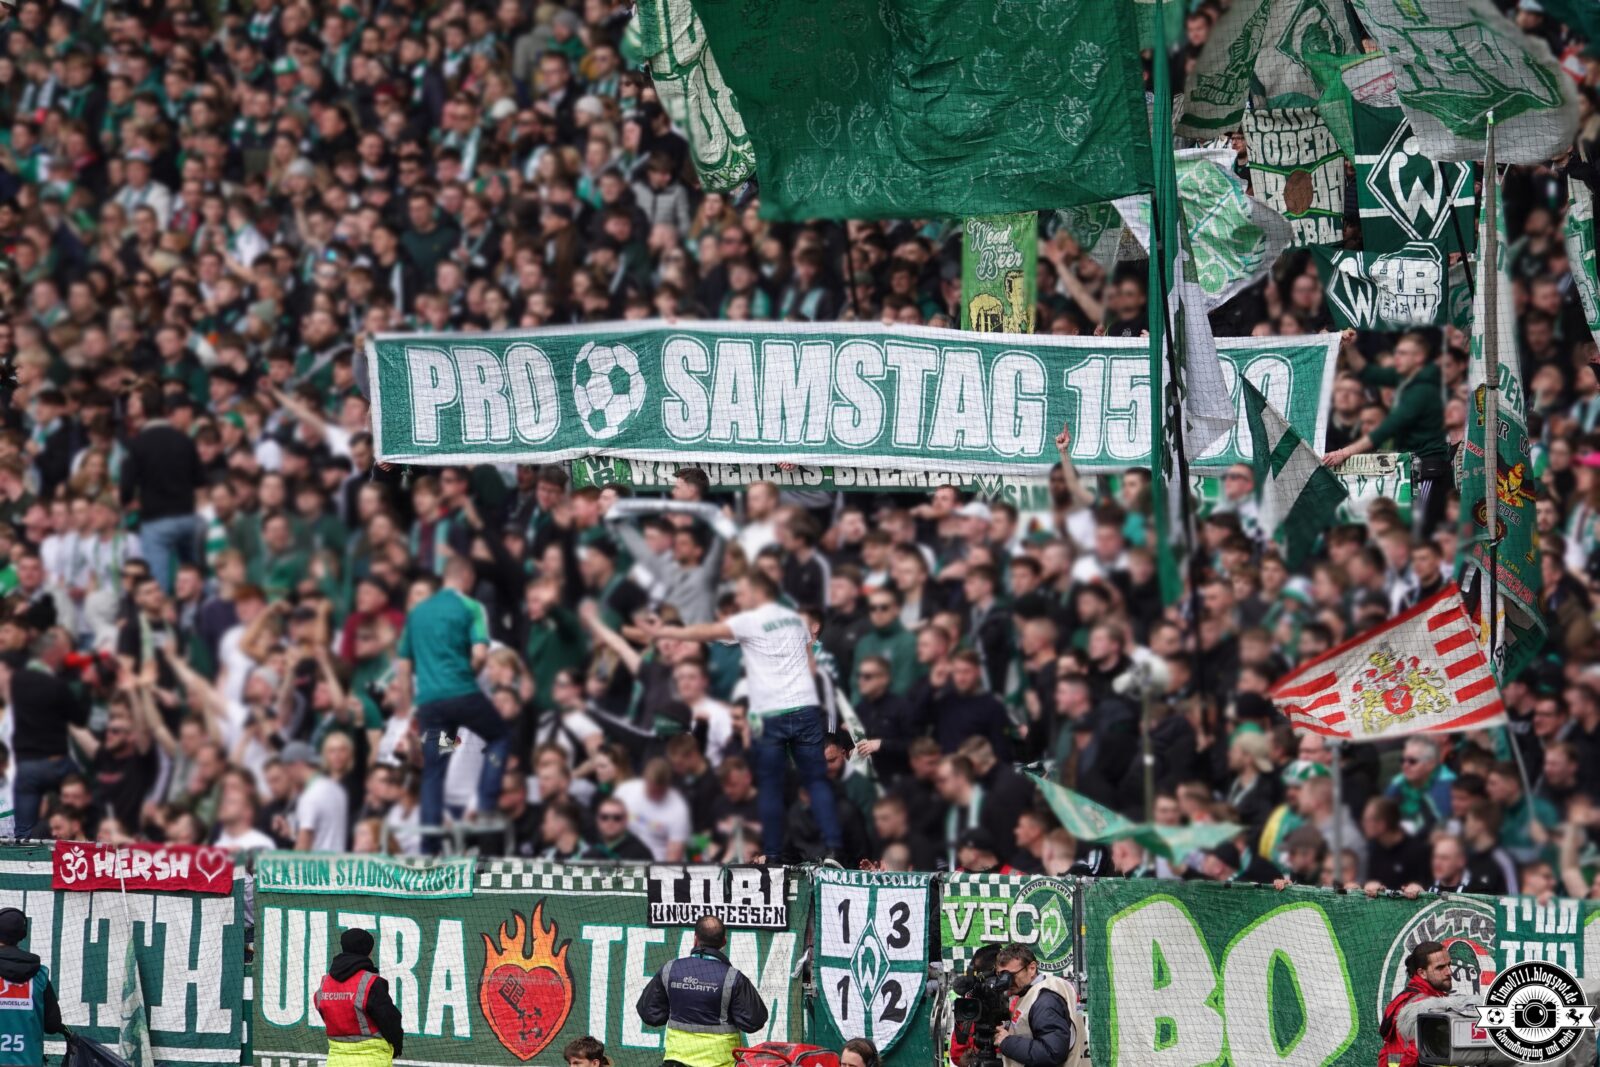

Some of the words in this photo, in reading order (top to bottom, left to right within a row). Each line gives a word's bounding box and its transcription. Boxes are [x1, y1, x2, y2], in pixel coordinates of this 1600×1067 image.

[966, 217, 1012, 251] Weed
[997, 243, 1014, 253] and
[976, 246, 1023, 280] Beer
[405, 342, 561, 446] PRO
[661, 334, 1049, 459] SAMSTAG
[1063, 353, 1294, 461] 150
[630, 459, 972, 487] WADERERS-BREMEN
[92, 848, 191, 881] HERSH
[261, 859, 330, 886] SEKTION
[336, 860, 468, 891] STADIONVERBOT
[820, 869, 860, 885] NIQUE
[882, 874, 929, 887] POLICE
[649, 865, 785, 905] TOBI
[838, 898, 850, 944] 1
[886, 901, 910, 950] 3
[942, 902, 1039, 943] VEC
[321, 992, 356, 1001] SECURITY
[581, 924, 798, 1049] TEM
[670, 981, 719, 993] SECURITY
[837, 975, 850, 1020] 1
[879, 979, 908, 1023] 2
